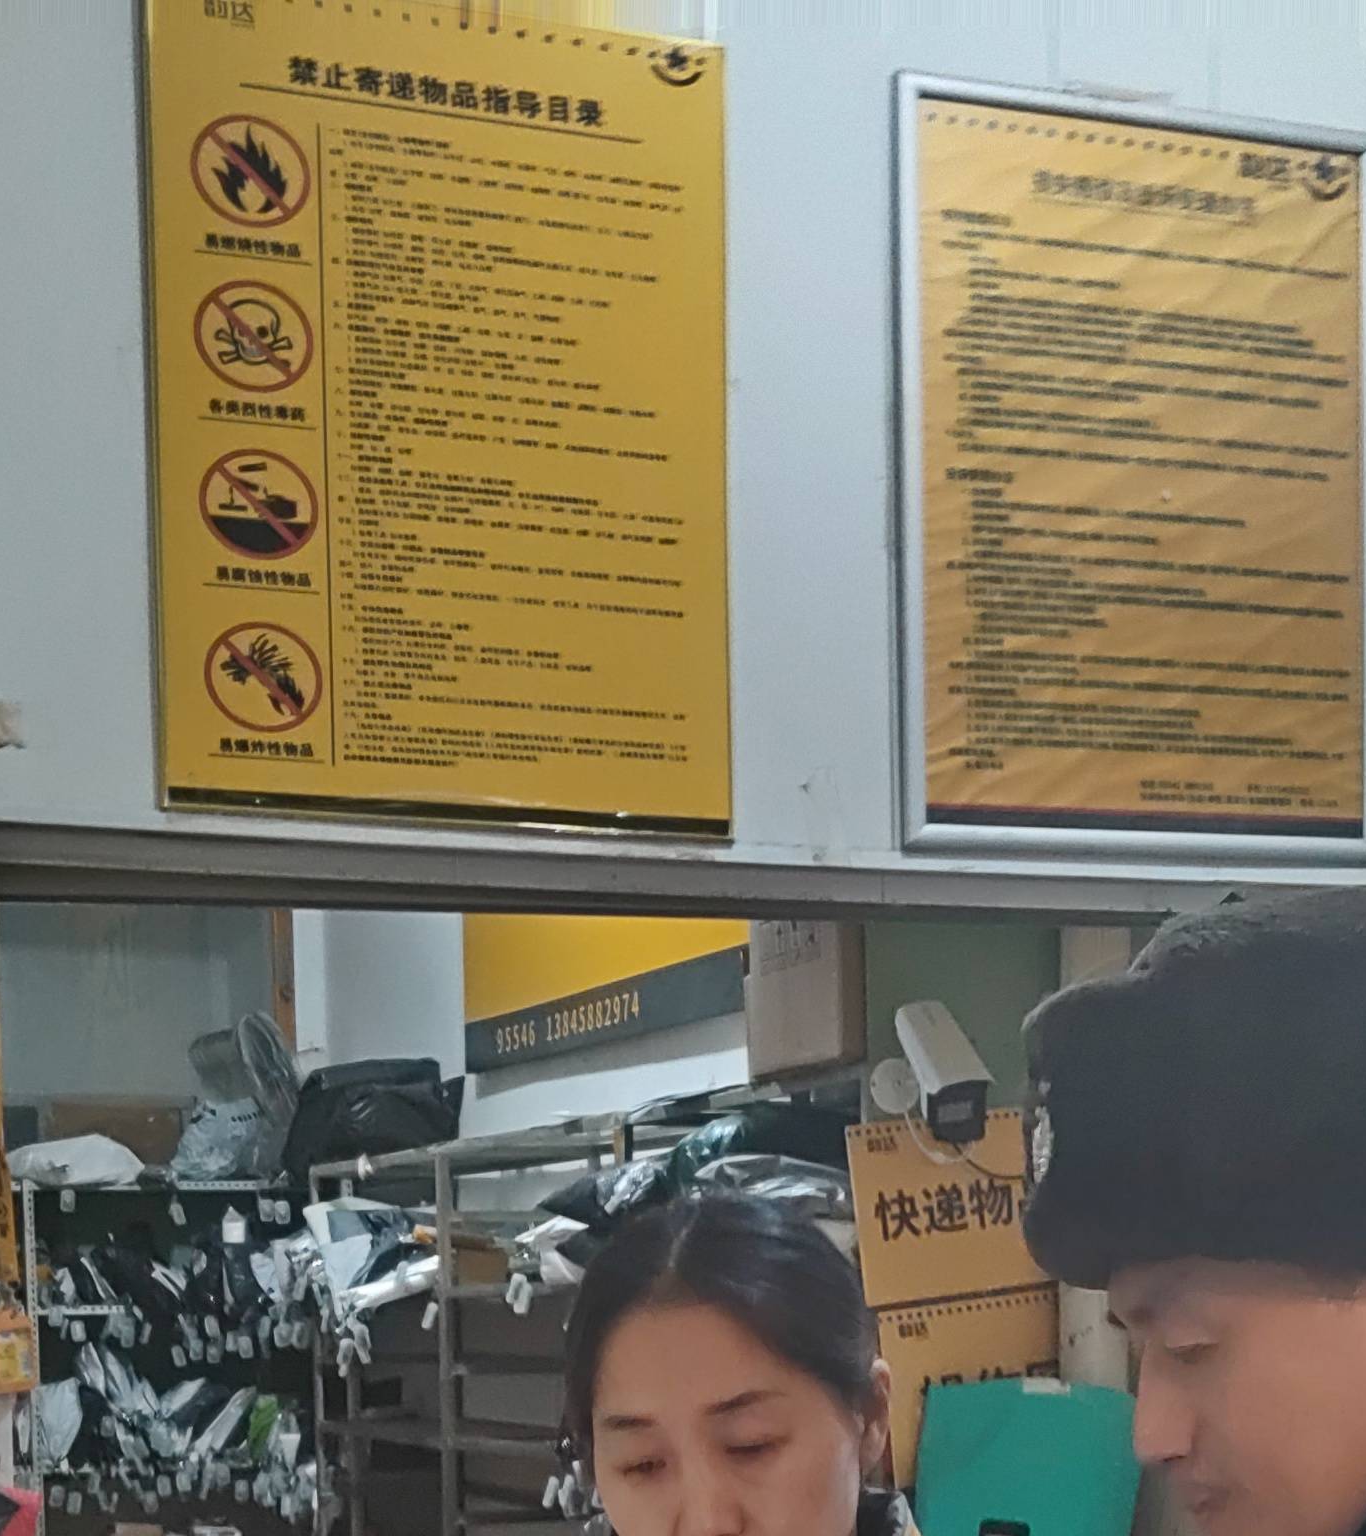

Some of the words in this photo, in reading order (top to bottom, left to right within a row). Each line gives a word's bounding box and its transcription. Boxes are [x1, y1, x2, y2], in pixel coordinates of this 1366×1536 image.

[287, 55, 604, 127] 禁止寄递物品指导目录
[546, 991, 640, 1042] 13845882974
[873, 1177, 1026, 1242] 快递物
